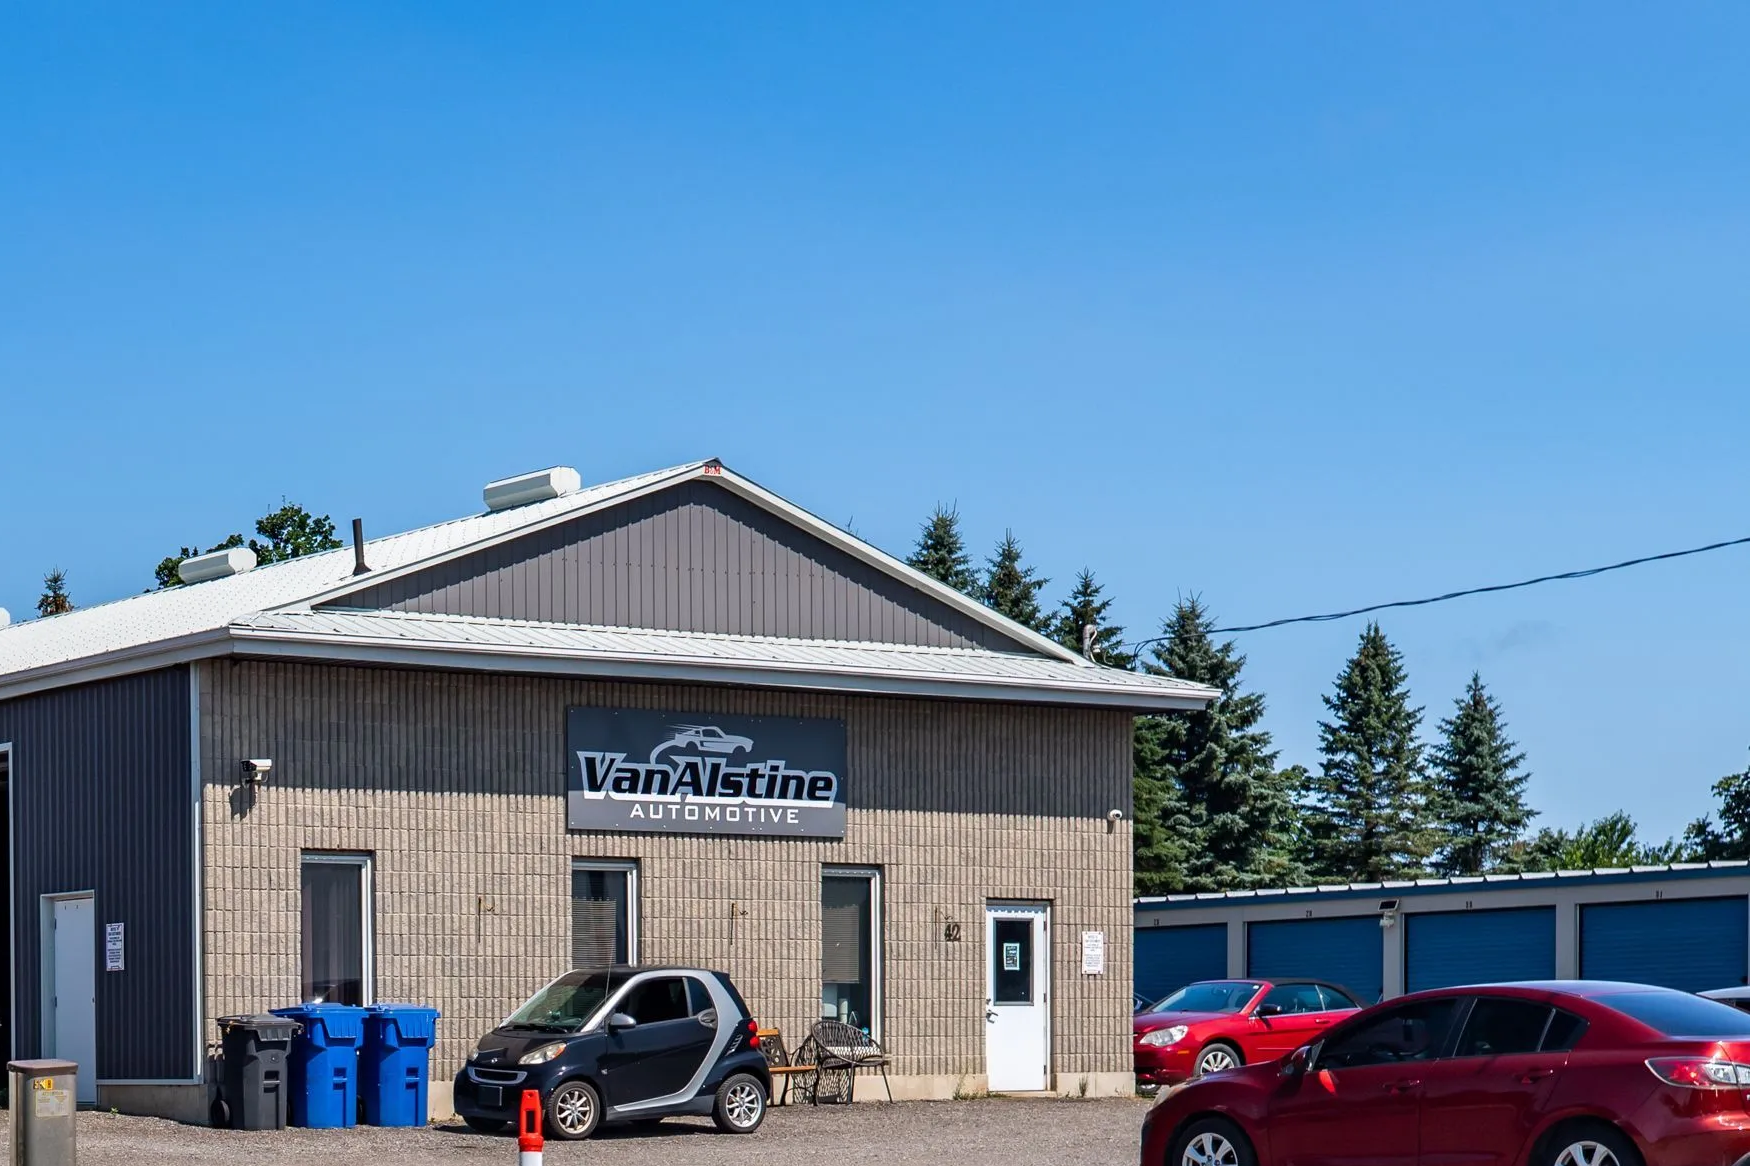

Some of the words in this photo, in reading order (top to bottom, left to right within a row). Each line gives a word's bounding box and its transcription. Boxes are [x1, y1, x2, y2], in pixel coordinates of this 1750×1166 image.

[577, 752, 838, 807] VanAlstine
[630, 804, 800, 824] AUTOMOTIVE
[944, 923, 961, 942] 42
